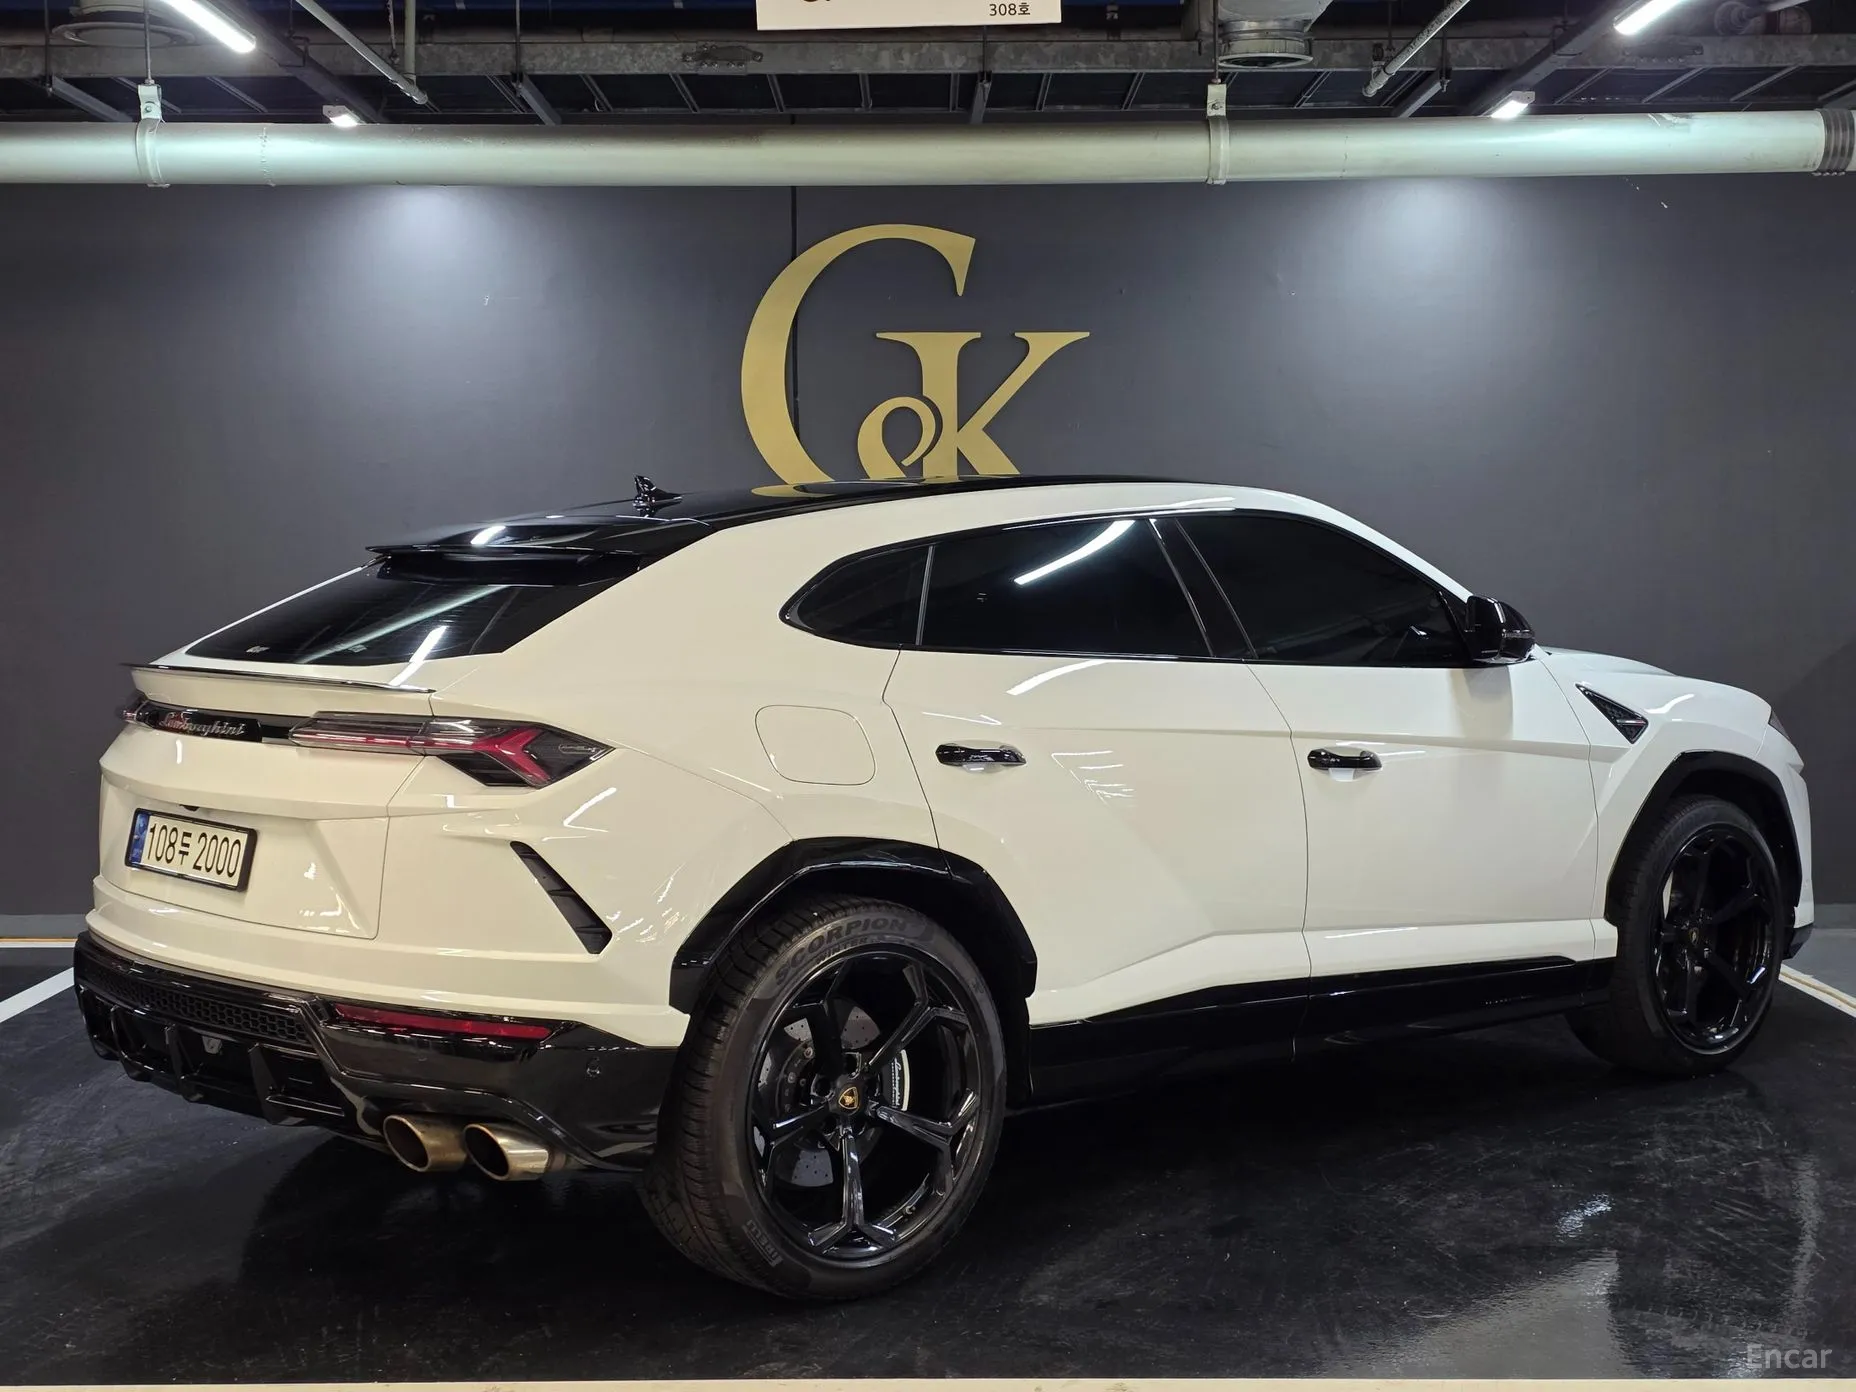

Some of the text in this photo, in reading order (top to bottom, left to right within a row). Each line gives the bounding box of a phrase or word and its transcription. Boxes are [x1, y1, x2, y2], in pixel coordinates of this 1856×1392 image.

[989, 2, 1031, 16] 308호
[148, 823, 241, 877] 108두 2000
[775, 917, 907, 985] SCORPION
